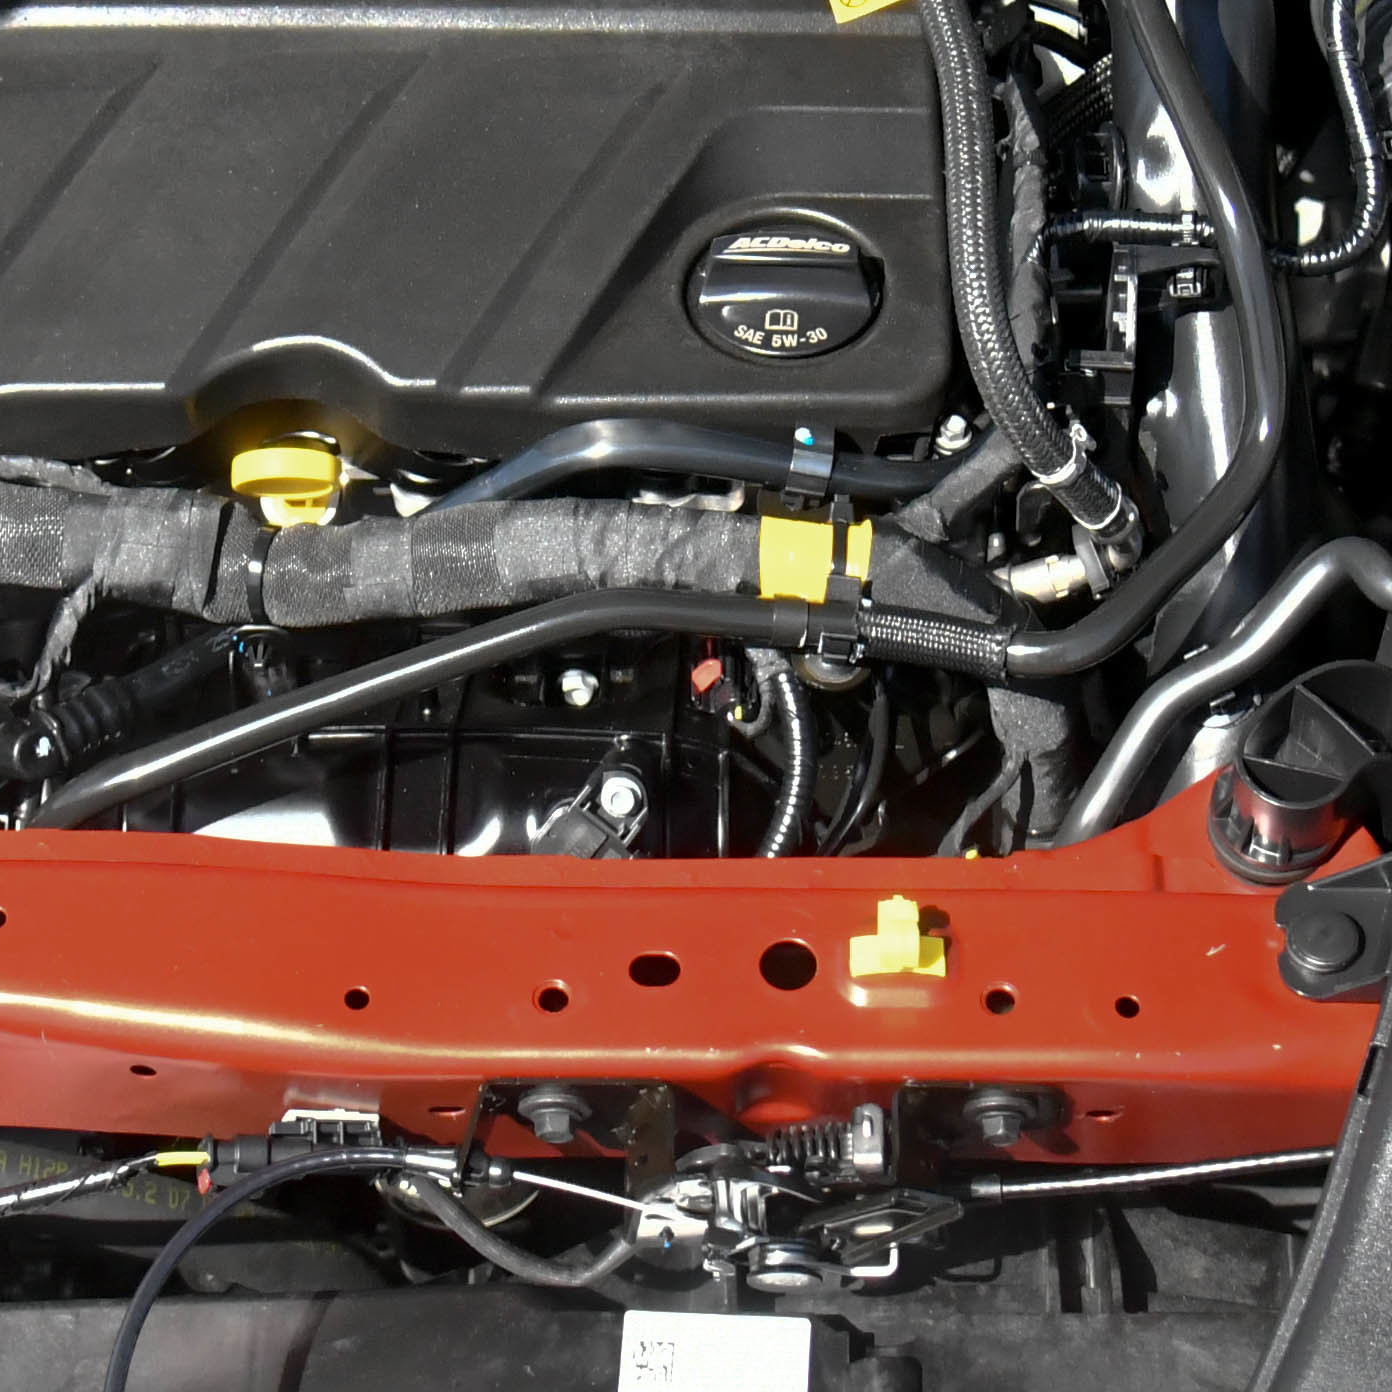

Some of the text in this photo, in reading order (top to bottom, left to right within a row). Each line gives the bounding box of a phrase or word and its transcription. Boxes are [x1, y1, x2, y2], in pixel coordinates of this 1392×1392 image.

[728, 236, 850, 254] ACDelco
[733, 324, 828, 348] SAE 5W-30
